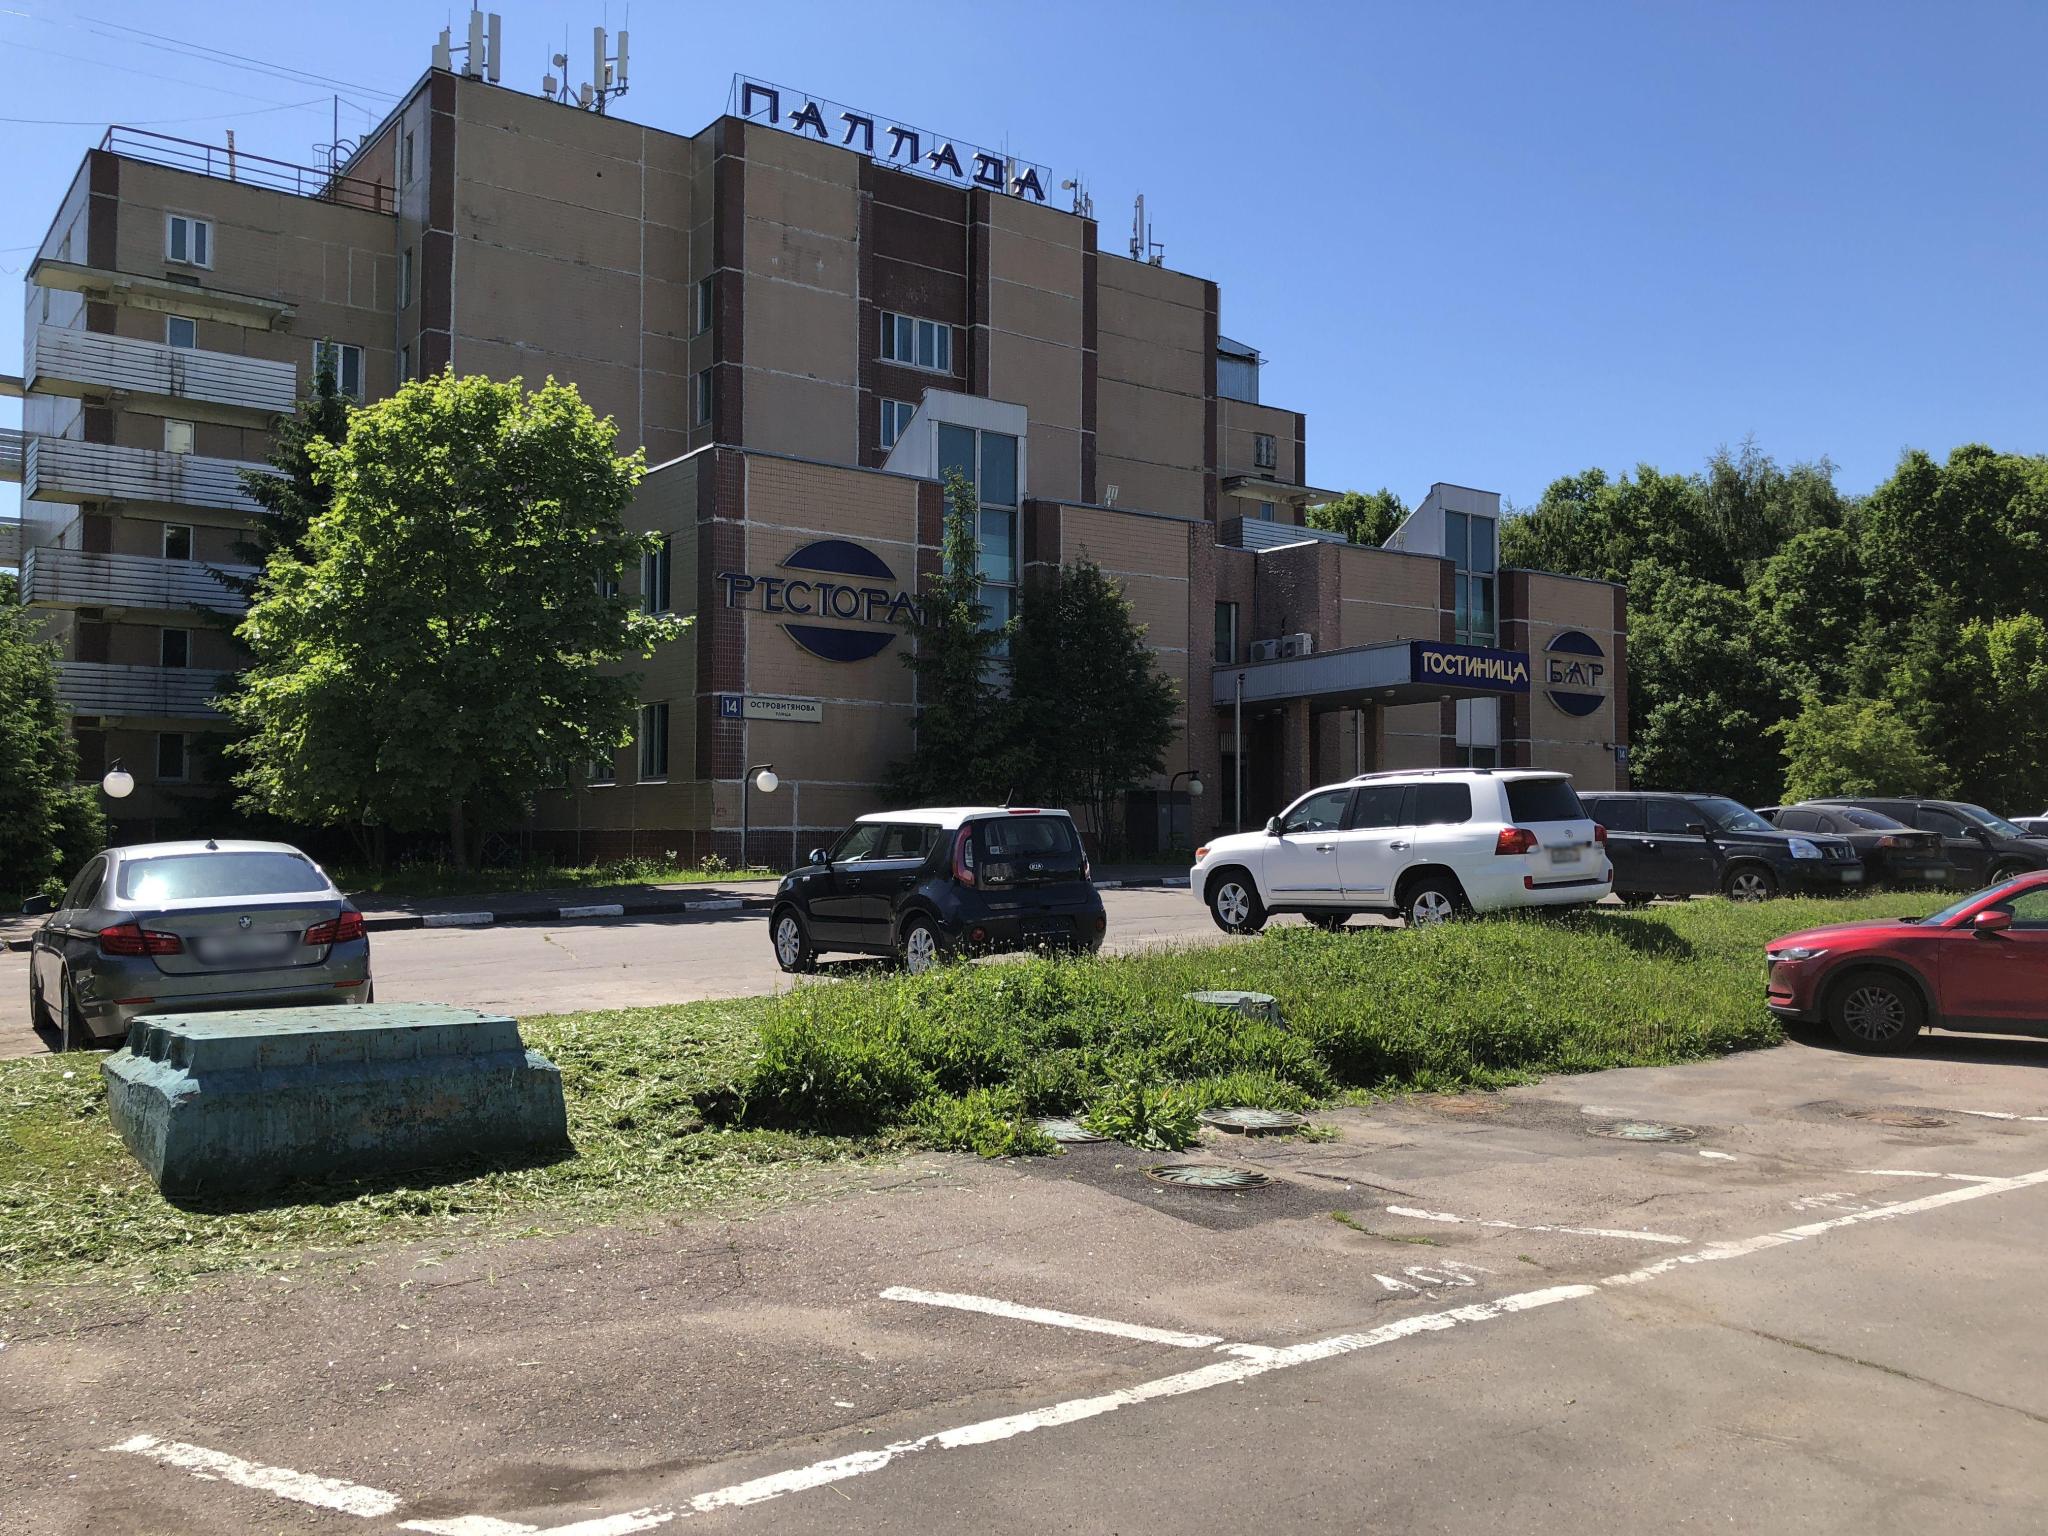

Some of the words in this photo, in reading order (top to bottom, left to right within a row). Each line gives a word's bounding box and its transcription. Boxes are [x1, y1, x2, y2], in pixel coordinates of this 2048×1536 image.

[742, 81, 1046, 201] ПАЛЛАДА
[1422, 651, 1528, 684] ГОСТИНИЦА
[1545, 658, 1604, 687] БАР
[725, 699, 737, 713] 14
[750, 701, 816, 712] ОСТРОВИТЯНОВА
[1029, 862, 1043, 871] KIA
